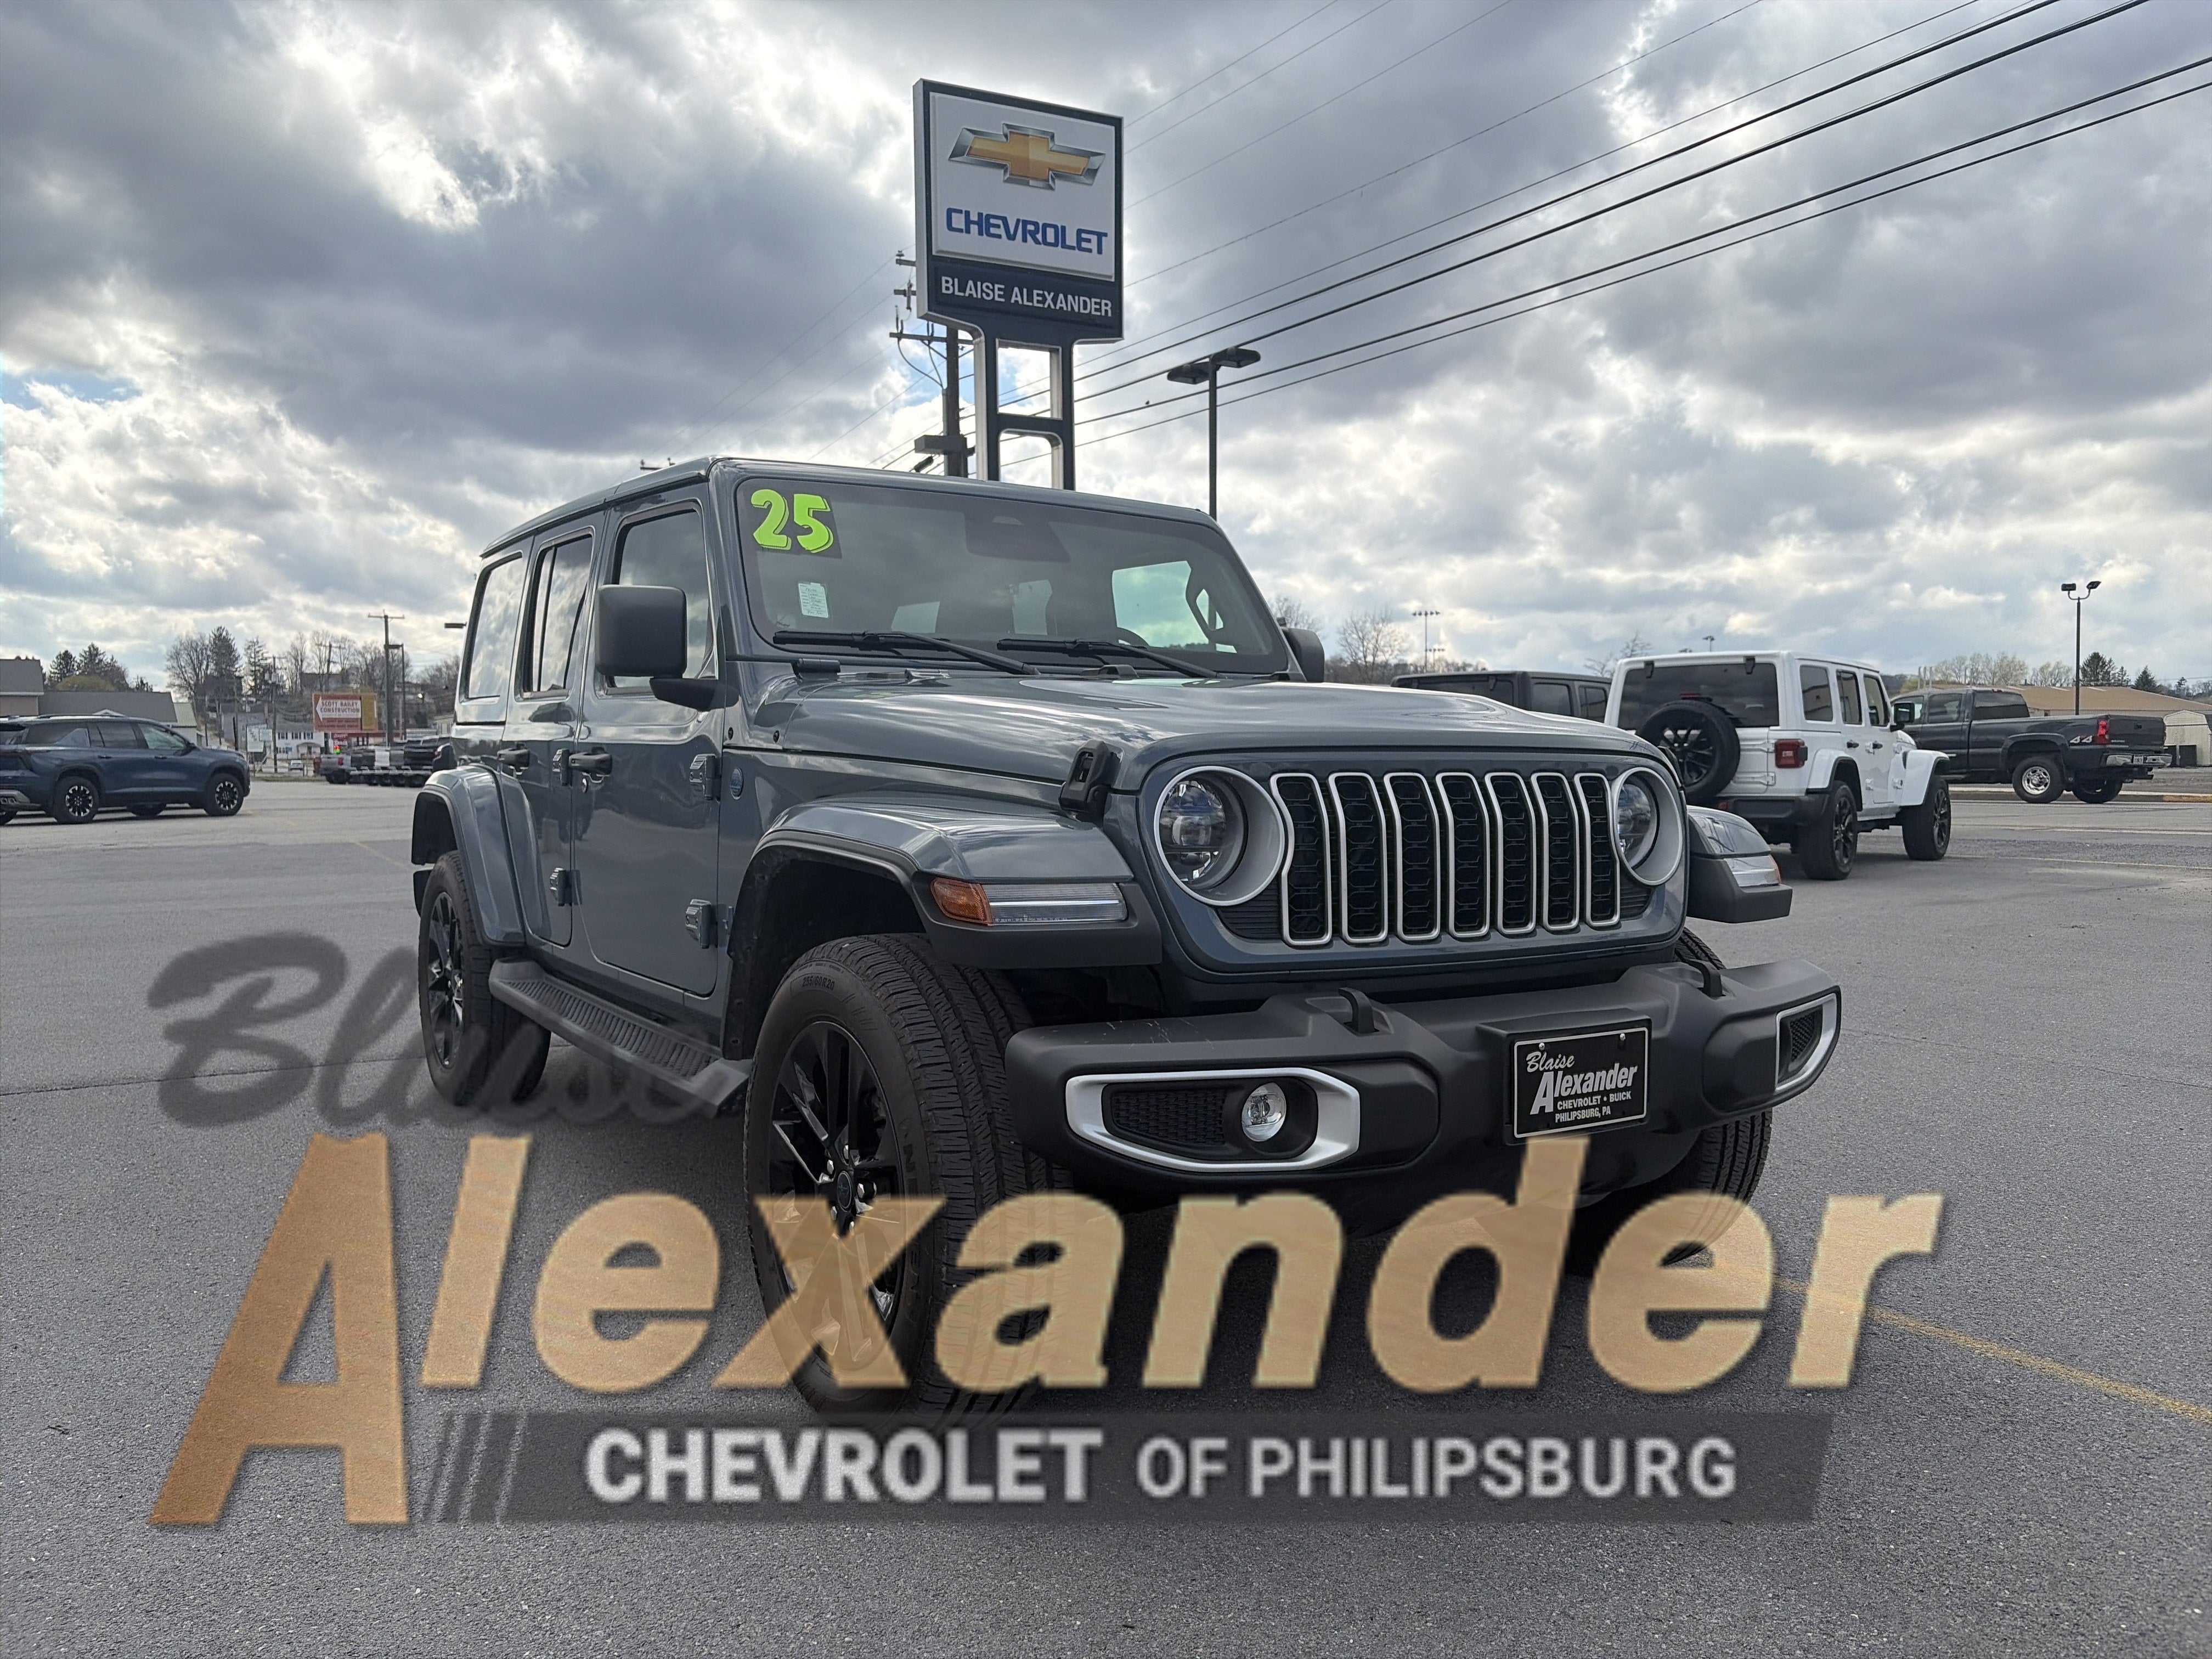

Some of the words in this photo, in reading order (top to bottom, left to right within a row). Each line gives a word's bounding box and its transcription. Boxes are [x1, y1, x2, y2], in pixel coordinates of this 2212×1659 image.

[946, 207, 1108, 255] CHEVROLET
[941, 276, 1005, 302] BLAISE
[1011, 287, 1112, 317] ALEXANDER
[751, 489, 834, 553] 25
[1526, 1051, 1575, 1073] Blaise
[1530, 1063, 1638, 1115] Alexander
[1557, 1096, 1601, 1110] CHEVROLET
[1609, 1091, 1632, 1102] BUICK
[1555, 1107, 1601, 1122] PHILIPSBURG,
[1602, 1105, 1611, 1115] PA
